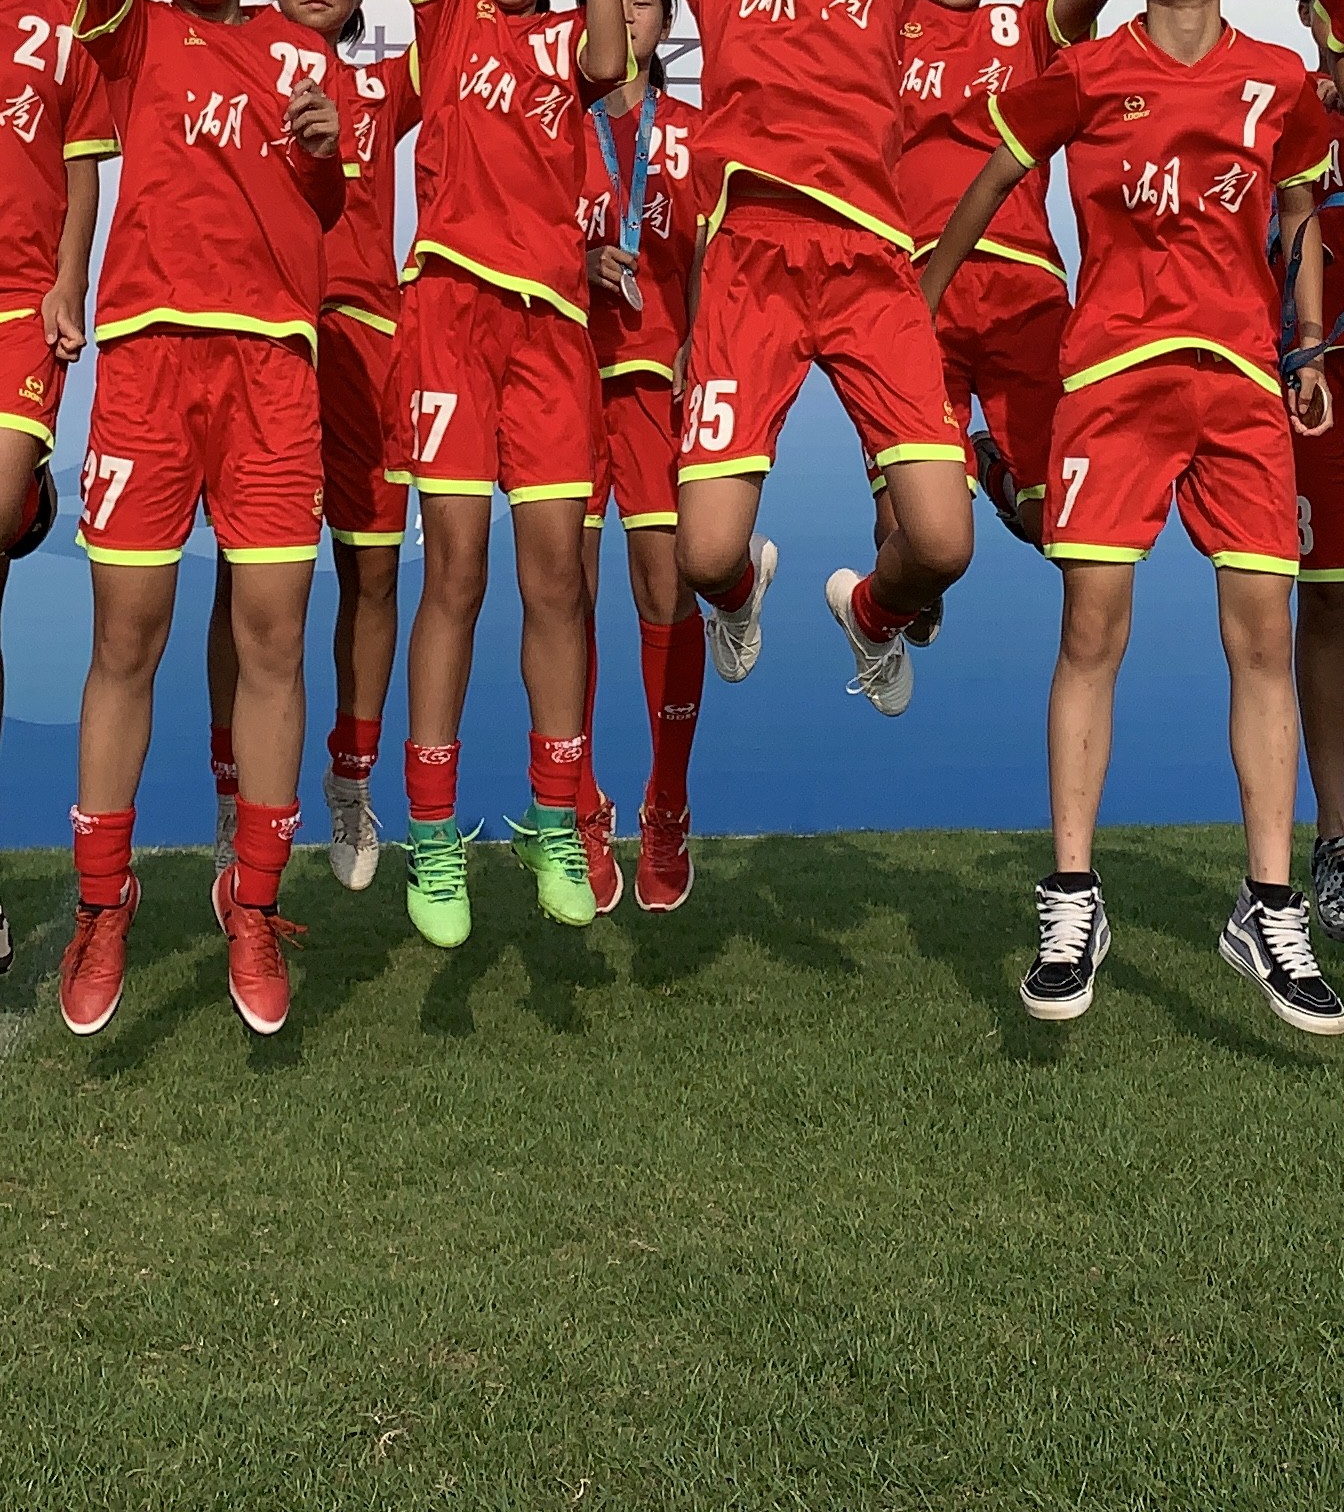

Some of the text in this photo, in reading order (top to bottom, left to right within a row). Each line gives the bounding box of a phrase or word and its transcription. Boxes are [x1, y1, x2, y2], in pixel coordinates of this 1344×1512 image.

[13, 15, 72, 86] 21
[527, 20, 574, 81] 17
[989, 6, 1020, 47] 8
[269, 41, 327, 99] 27
[459, 52, 575, 140] 湖南
[1240, 79, 1277, 149] 7
[635, 124, 690, 181] 25
[1121, 156, 1258, 216] 湖南
[410, 390, 458, 464] 17
[682, 379, 738, 454] 35
[82, 450, 134, 530] 27
[1056, 457, 1090, 528] 7
